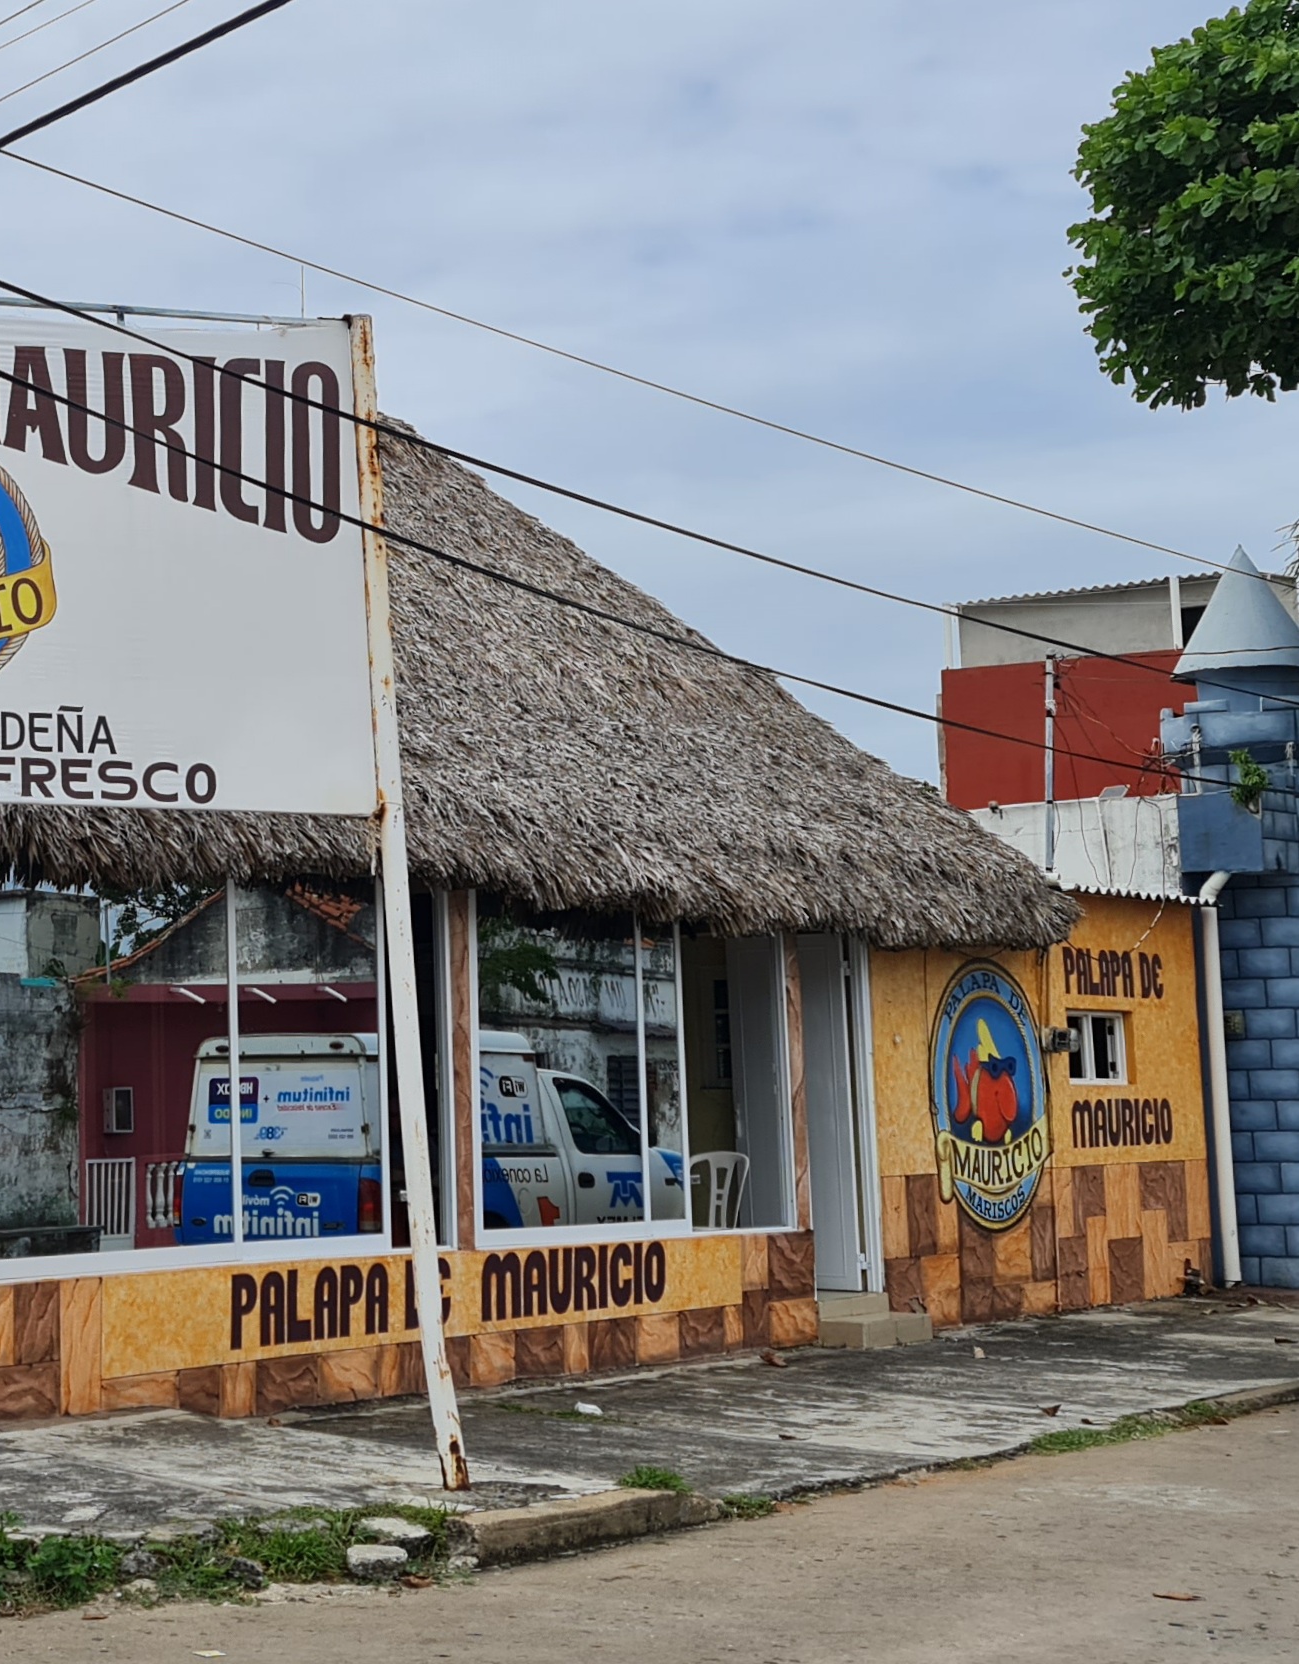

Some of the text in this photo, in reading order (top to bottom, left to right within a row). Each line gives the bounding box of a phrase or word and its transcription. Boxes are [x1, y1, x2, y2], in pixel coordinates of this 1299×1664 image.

[945, 972, 1028, 1026] PALAPA DE
[1062, 946, 1164, 999] PALAPA DE
[1071, 1097, 1173, 1149] MAURICIO
[950, 1128, 1044, 1186] MAURICIO
[965, 1184, 1026, 1219] MARISCOS
[230, 1262, 389, 1350] PALAPA
[481, 1241, 667, 1322] MAURICIO
